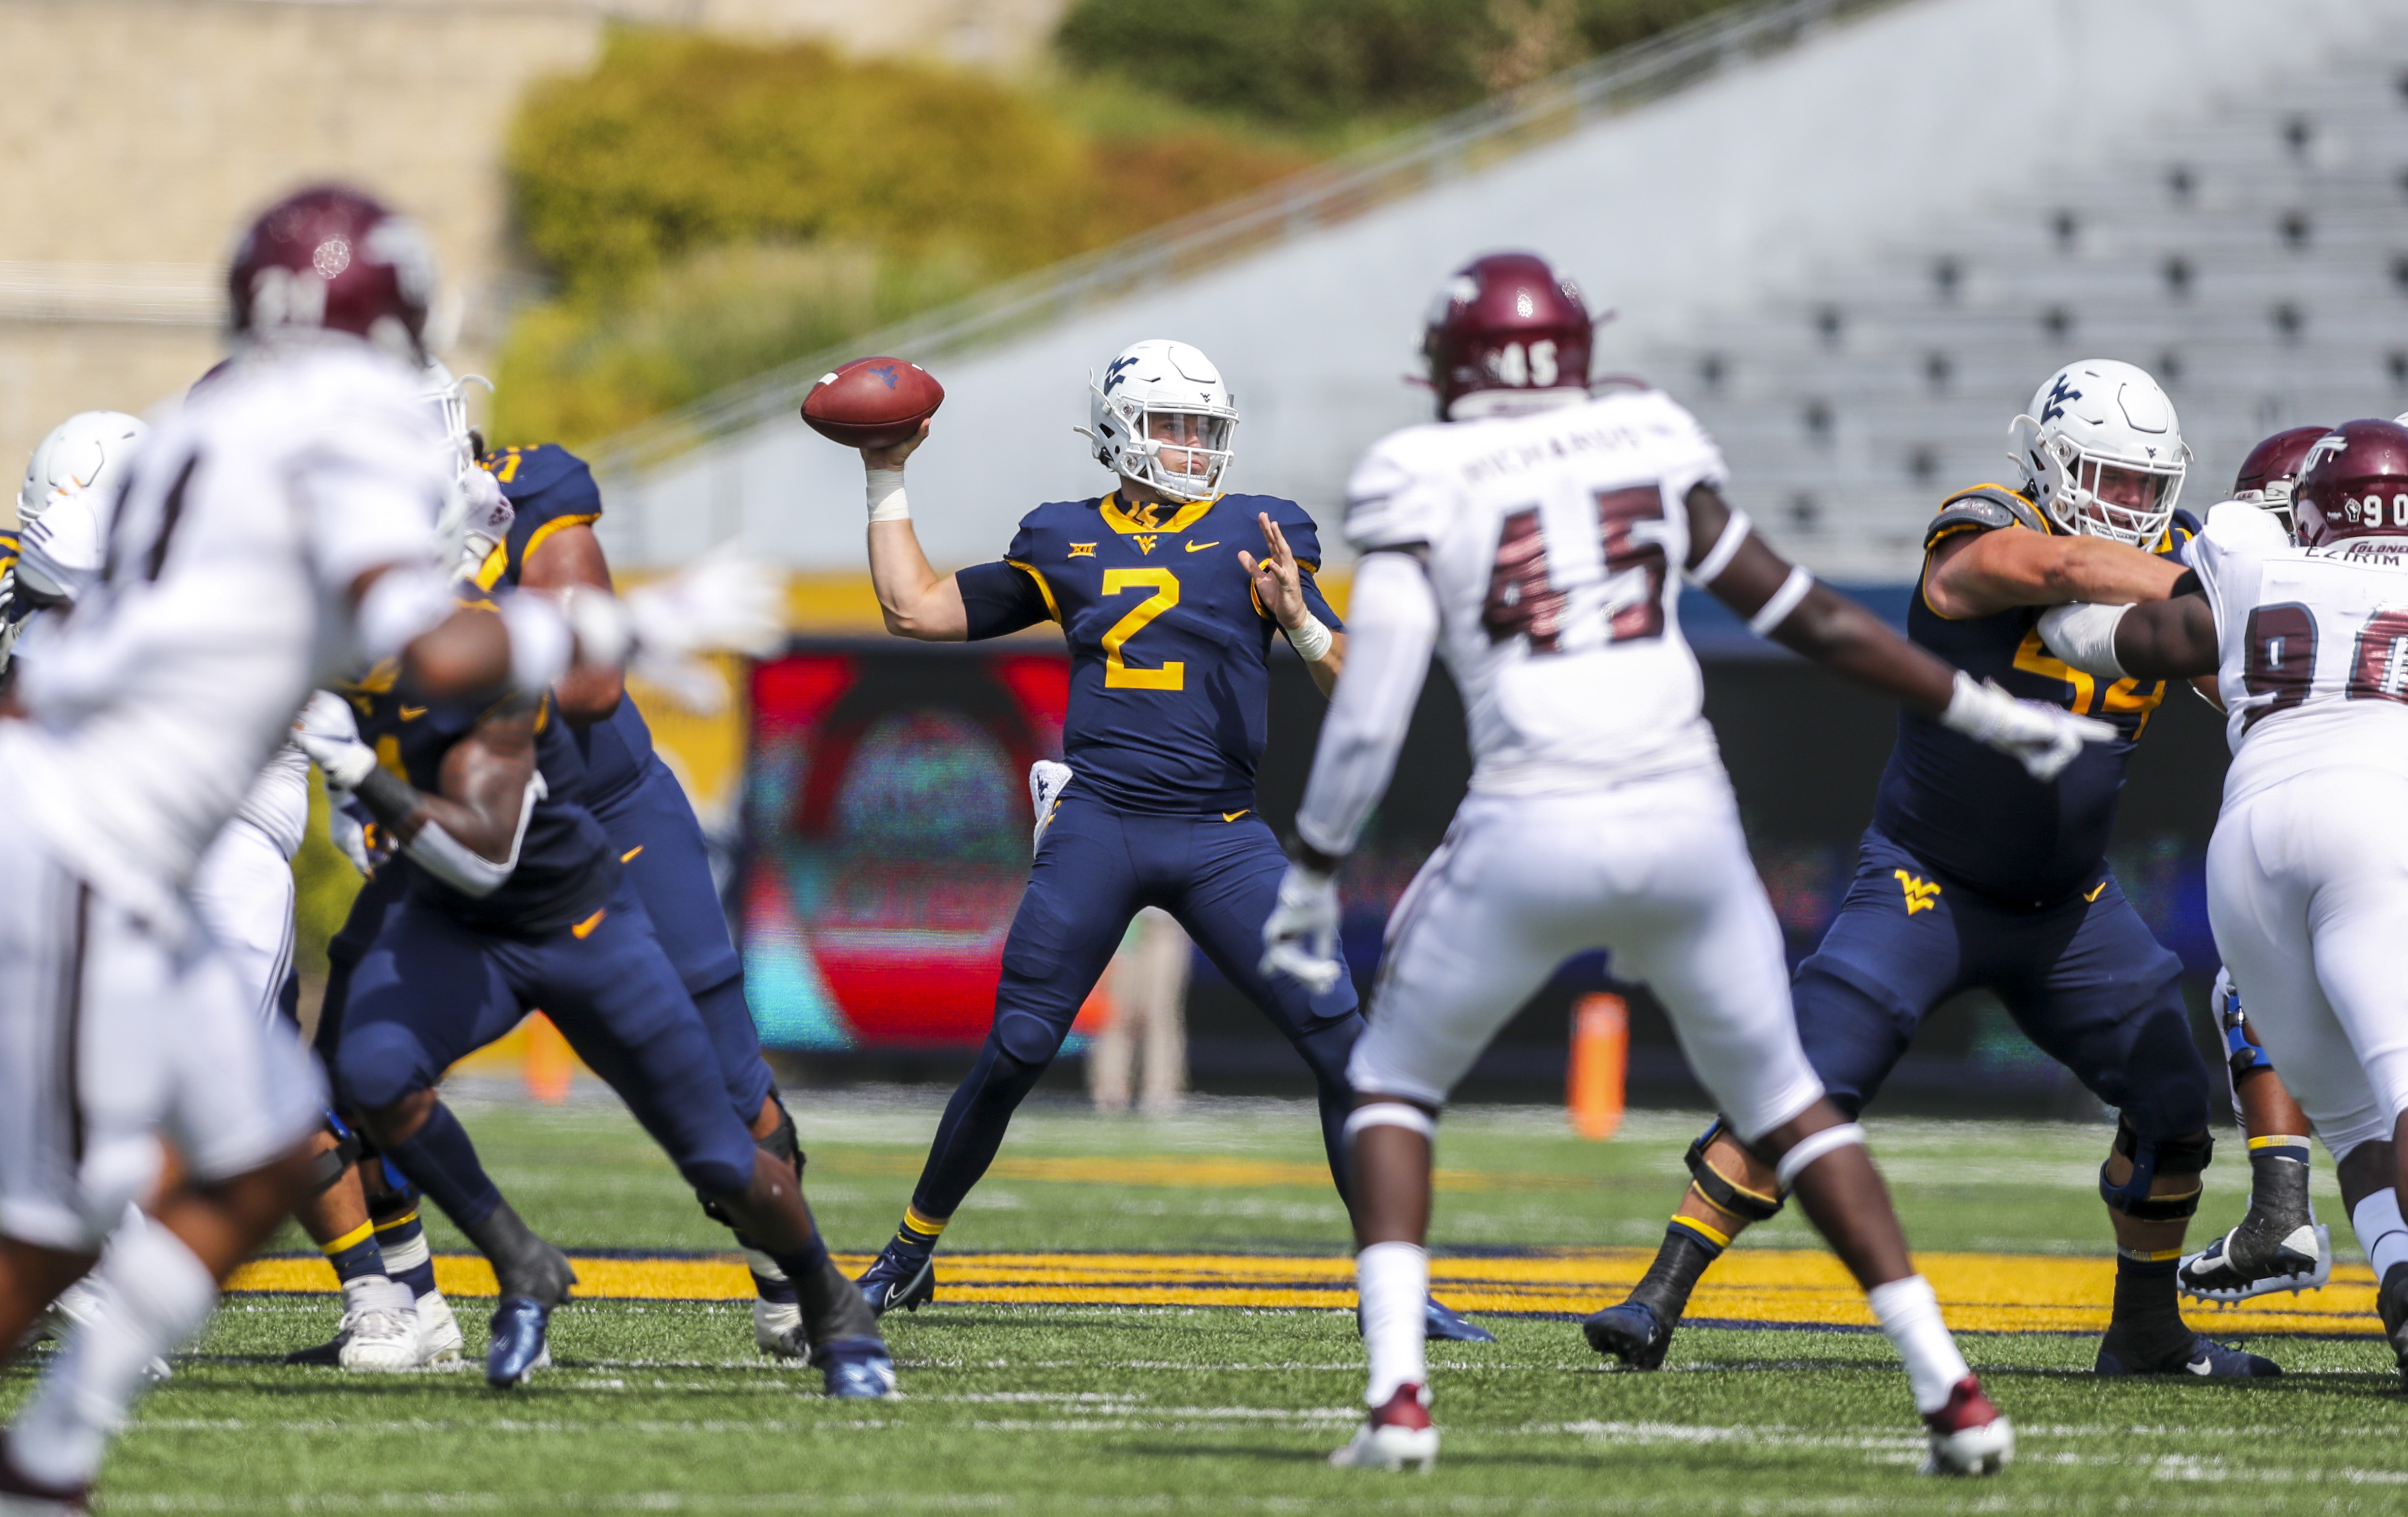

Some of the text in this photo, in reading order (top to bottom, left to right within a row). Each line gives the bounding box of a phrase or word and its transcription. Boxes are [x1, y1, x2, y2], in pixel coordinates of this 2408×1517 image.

[1500, 339, 1559, 388] 45
[2237, 492, 2254, 500] EKU
[2363, 494, 2408, 528] 90
[1481, 479, 1667, 657] 45
[1101, 567, 1184, 690] 2
[2240, 601, 2408, 738] 90
